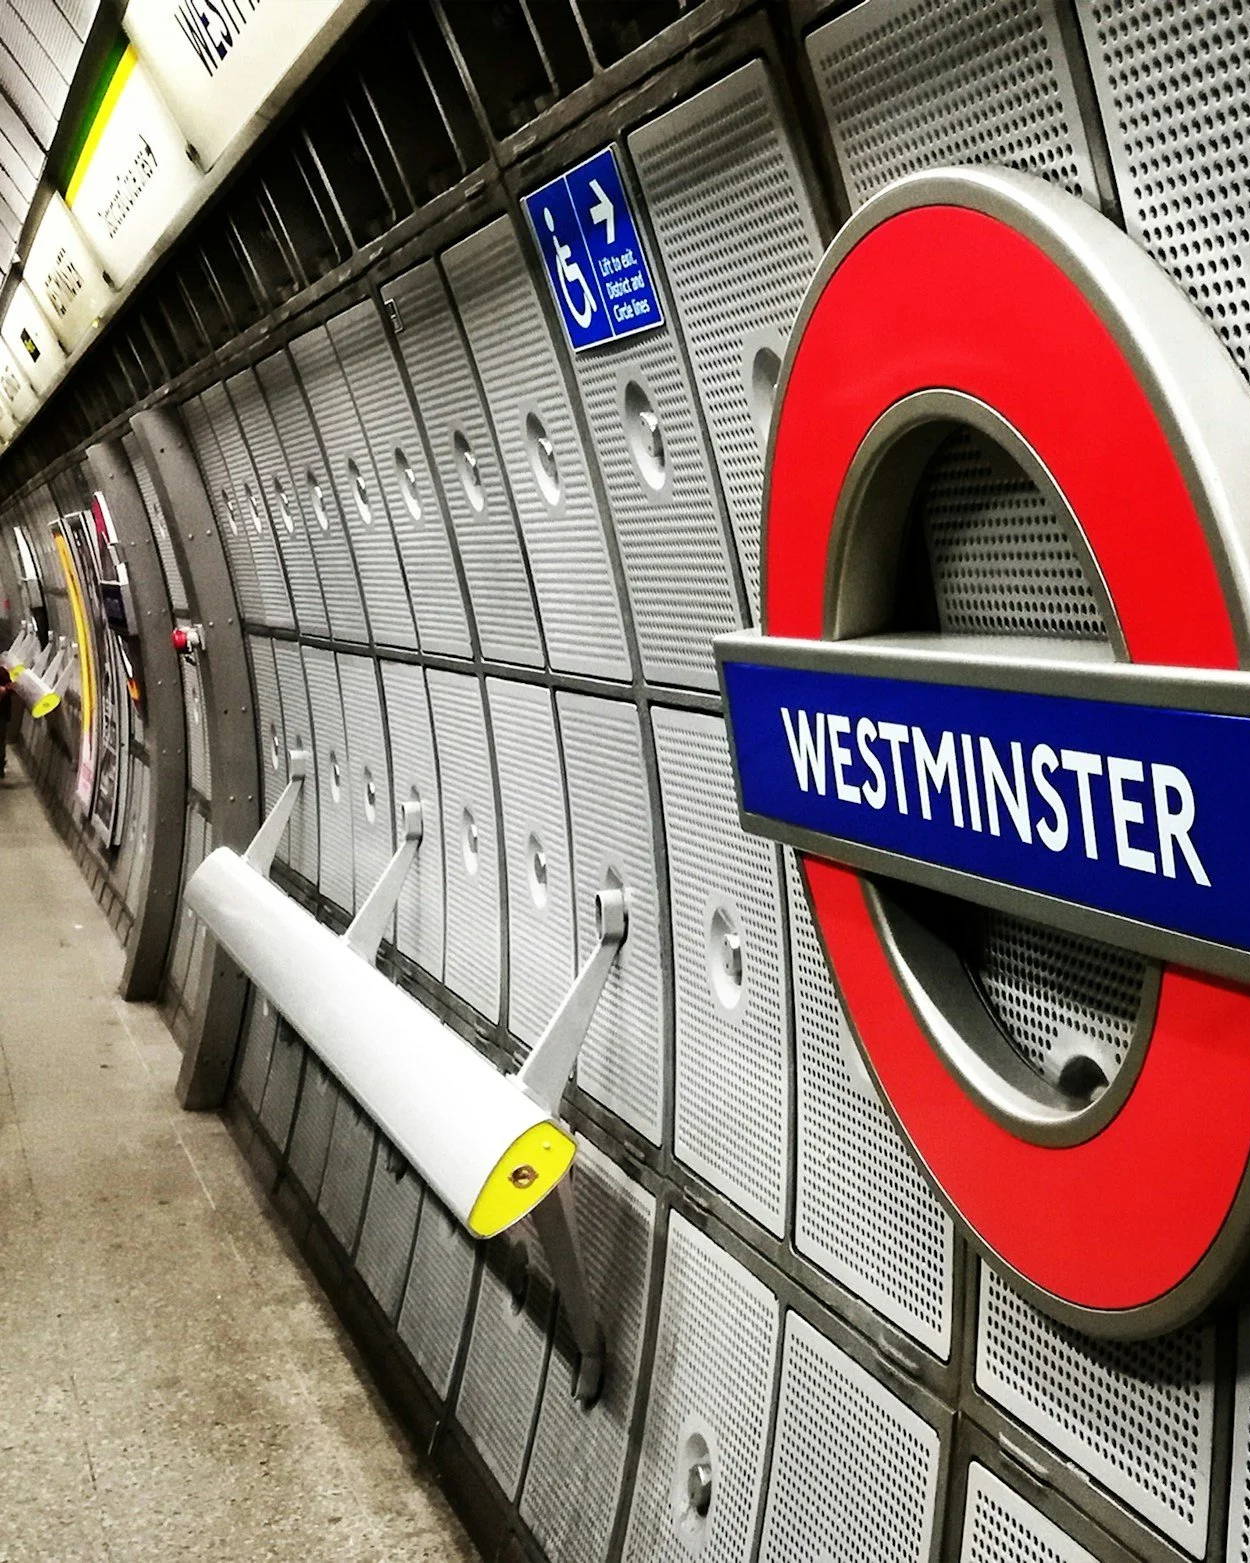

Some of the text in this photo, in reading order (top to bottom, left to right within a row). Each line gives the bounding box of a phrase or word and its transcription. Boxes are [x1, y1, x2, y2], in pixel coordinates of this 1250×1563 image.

[598, 257, 614, 277] Lift
[611, 256, 622, 272] to
[606, 270, 645, 300] District and
[613, 298, 650, 323] Circle lines
[781, 707, 1211, 887] WESTMINSTER
